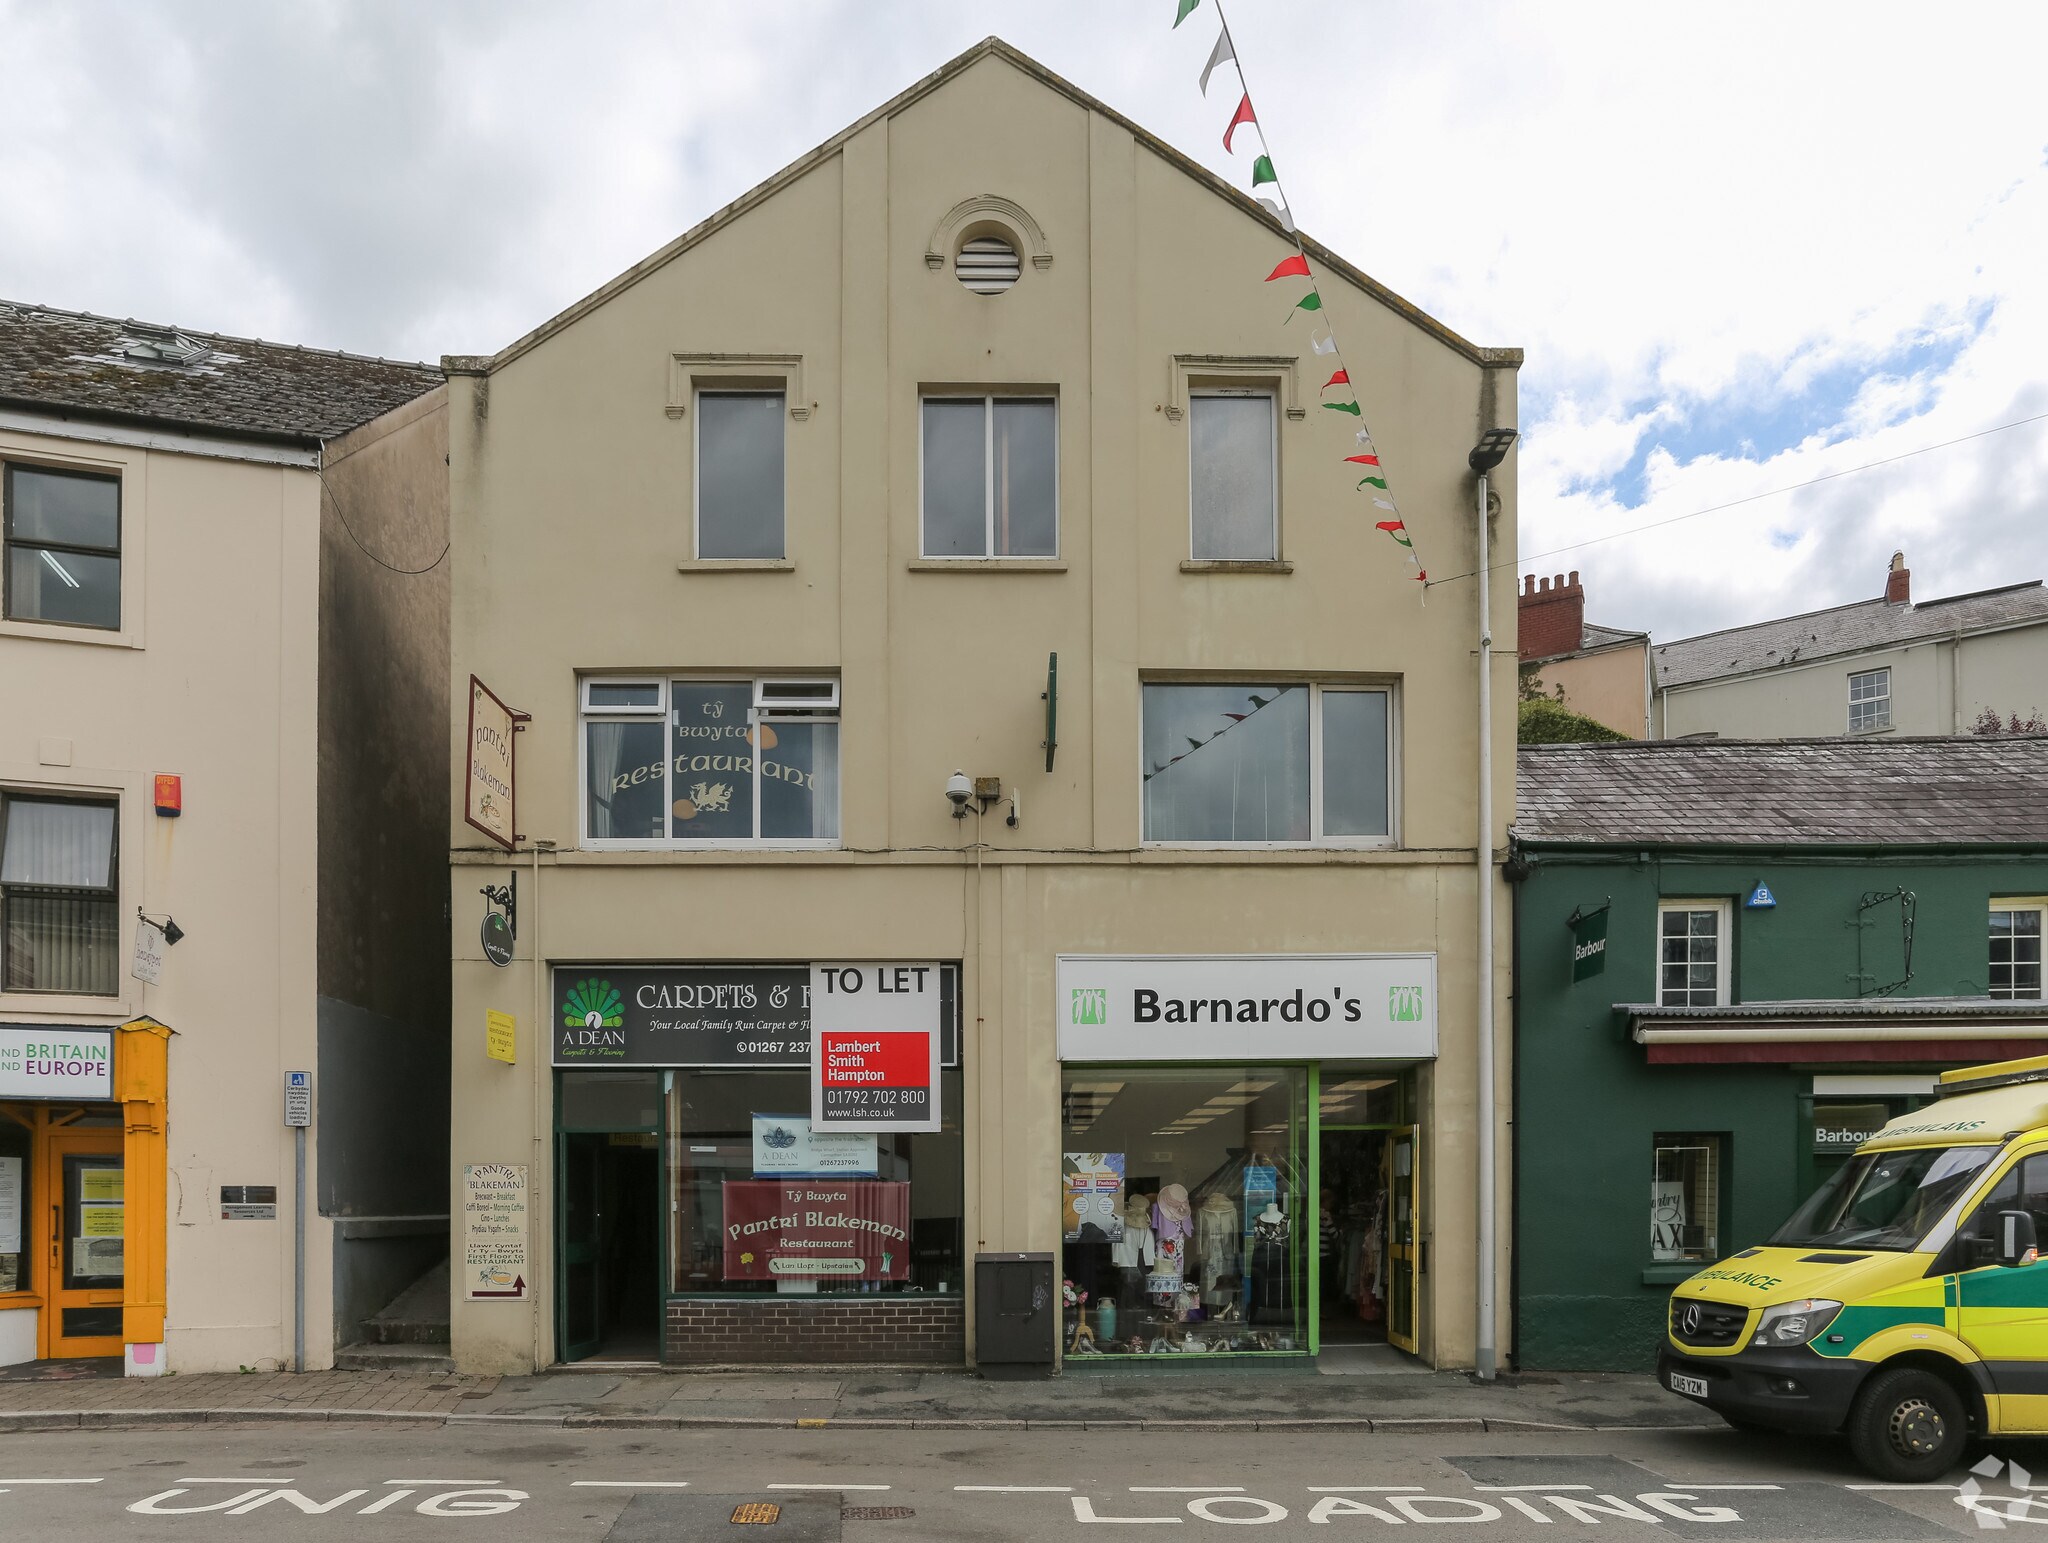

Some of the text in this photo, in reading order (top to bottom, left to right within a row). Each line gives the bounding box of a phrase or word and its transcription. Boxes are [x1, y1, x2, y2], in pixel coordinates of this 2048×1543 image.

[156, 776, 175, 785] DYFED
[1575, 937, 1606, 960] Barbour
[821, 968, 930, 993] TO LET
[636, 984, 758, 1009] CARPETS
[769, 985, 790, 1009] &
[1133, 986, 1362, 1023] Barnardo's
[650, 1020, 672, 1031] Your
[673, 1020, 699, 1030] Local
[701, 1020, 733, 1032] Family
[735, 1020, 754, 1031] Run
[756, 1020, 786, 1032] Carpet
[562, 1031, 625, 1044] A DEAN
[26, 1043, 106, 1060] BRITAIN
[749, 1042, 784, 1053] 01267
[828, 1040, 880, 1053] Lambert
[828, 1055, 864, 1067] Smith
[26, 1060, 106, 1076] EUROPE
[828, 1069, 885, 1083] Hampton
[828, 1091, 925, 1104] 01792 702 800
[827, 1108, 895, 1117] www.lsh.co.uk
[762, 1152, 768, 1160] A
[474, 1165, 515, 1180] PANTRI
[469, 1181, 519, 1189] BLAKEMAN
[497, 1192, 515, 1200] Breakfast
[806, 1190, 846, 1202] Bwyta
[493, 1203, 510, 1213] Morning
[511, 1203, 524, 1211] Coffee
[805, 1211, 906, 1242] Blakeman
[780, 1238, 854, 1248] Restaurant
[1686, 1379, 1702, 1395] YZM
[126, 1488, 530, 1517] UNIG
[1071, 1493, 1744, 1525] LOADING
